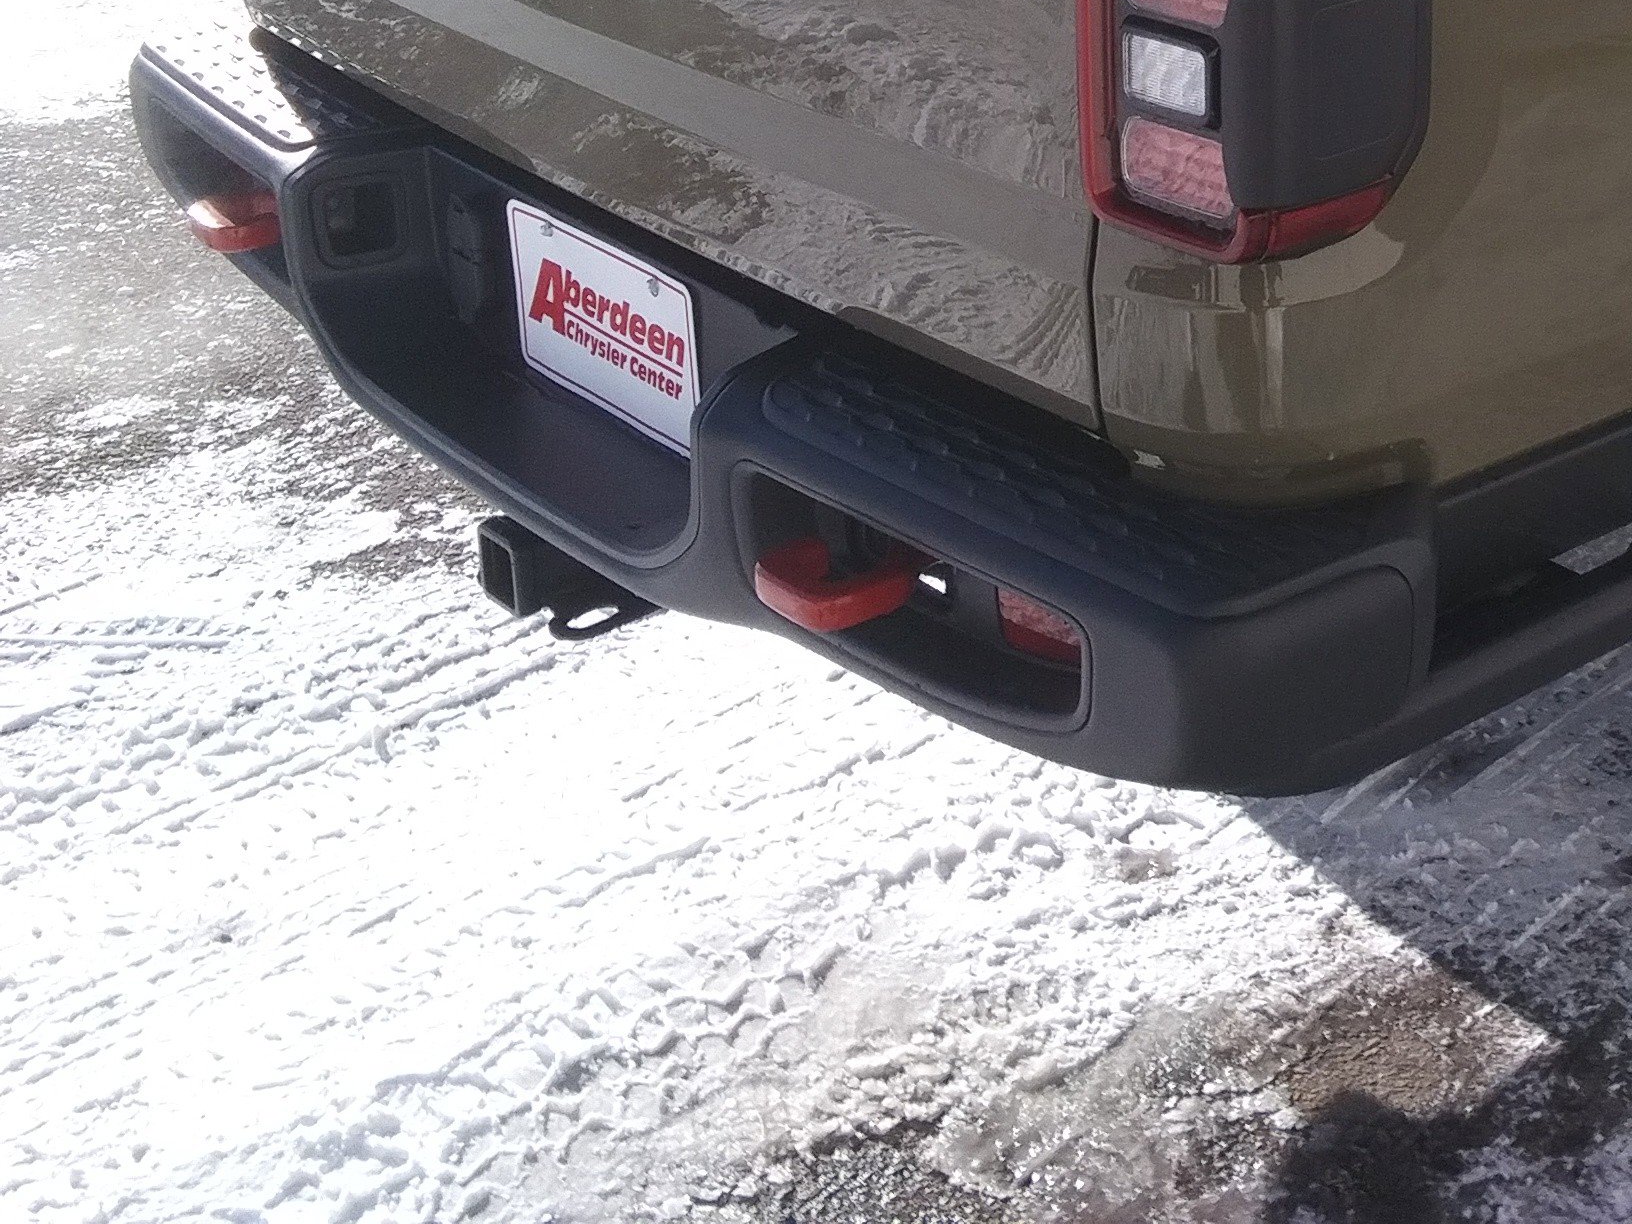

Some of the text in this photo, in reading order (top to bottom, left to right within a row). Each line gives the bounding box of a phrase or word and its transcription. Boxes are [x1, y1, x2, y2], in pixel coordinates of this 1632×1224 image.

[529, 258, 686, 368] Aberdeen
[566, 319, 683, 400] Chrysler Center
